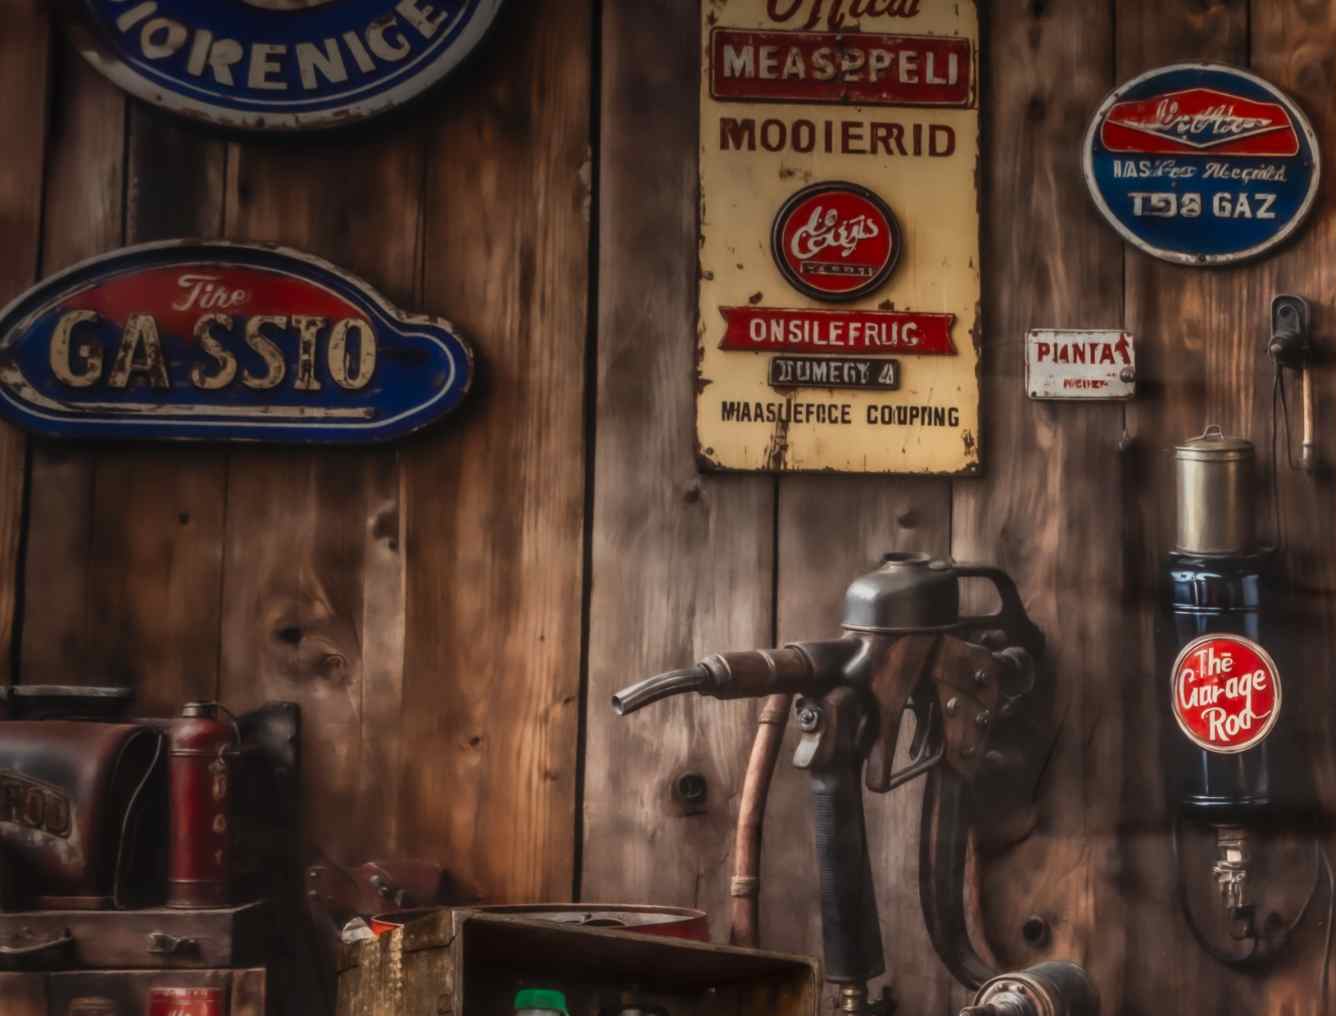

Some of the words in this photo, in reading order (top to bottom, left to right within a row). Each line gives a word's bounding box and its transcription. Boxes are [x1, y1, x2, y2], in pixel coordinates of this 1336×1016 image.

[1212, 192, 1278, 219] GAZ
[1196, 648, 1233, 677] The
[1179, 668, 1267, 710] Garage
[1201, 706, 1271, 742] Rod
